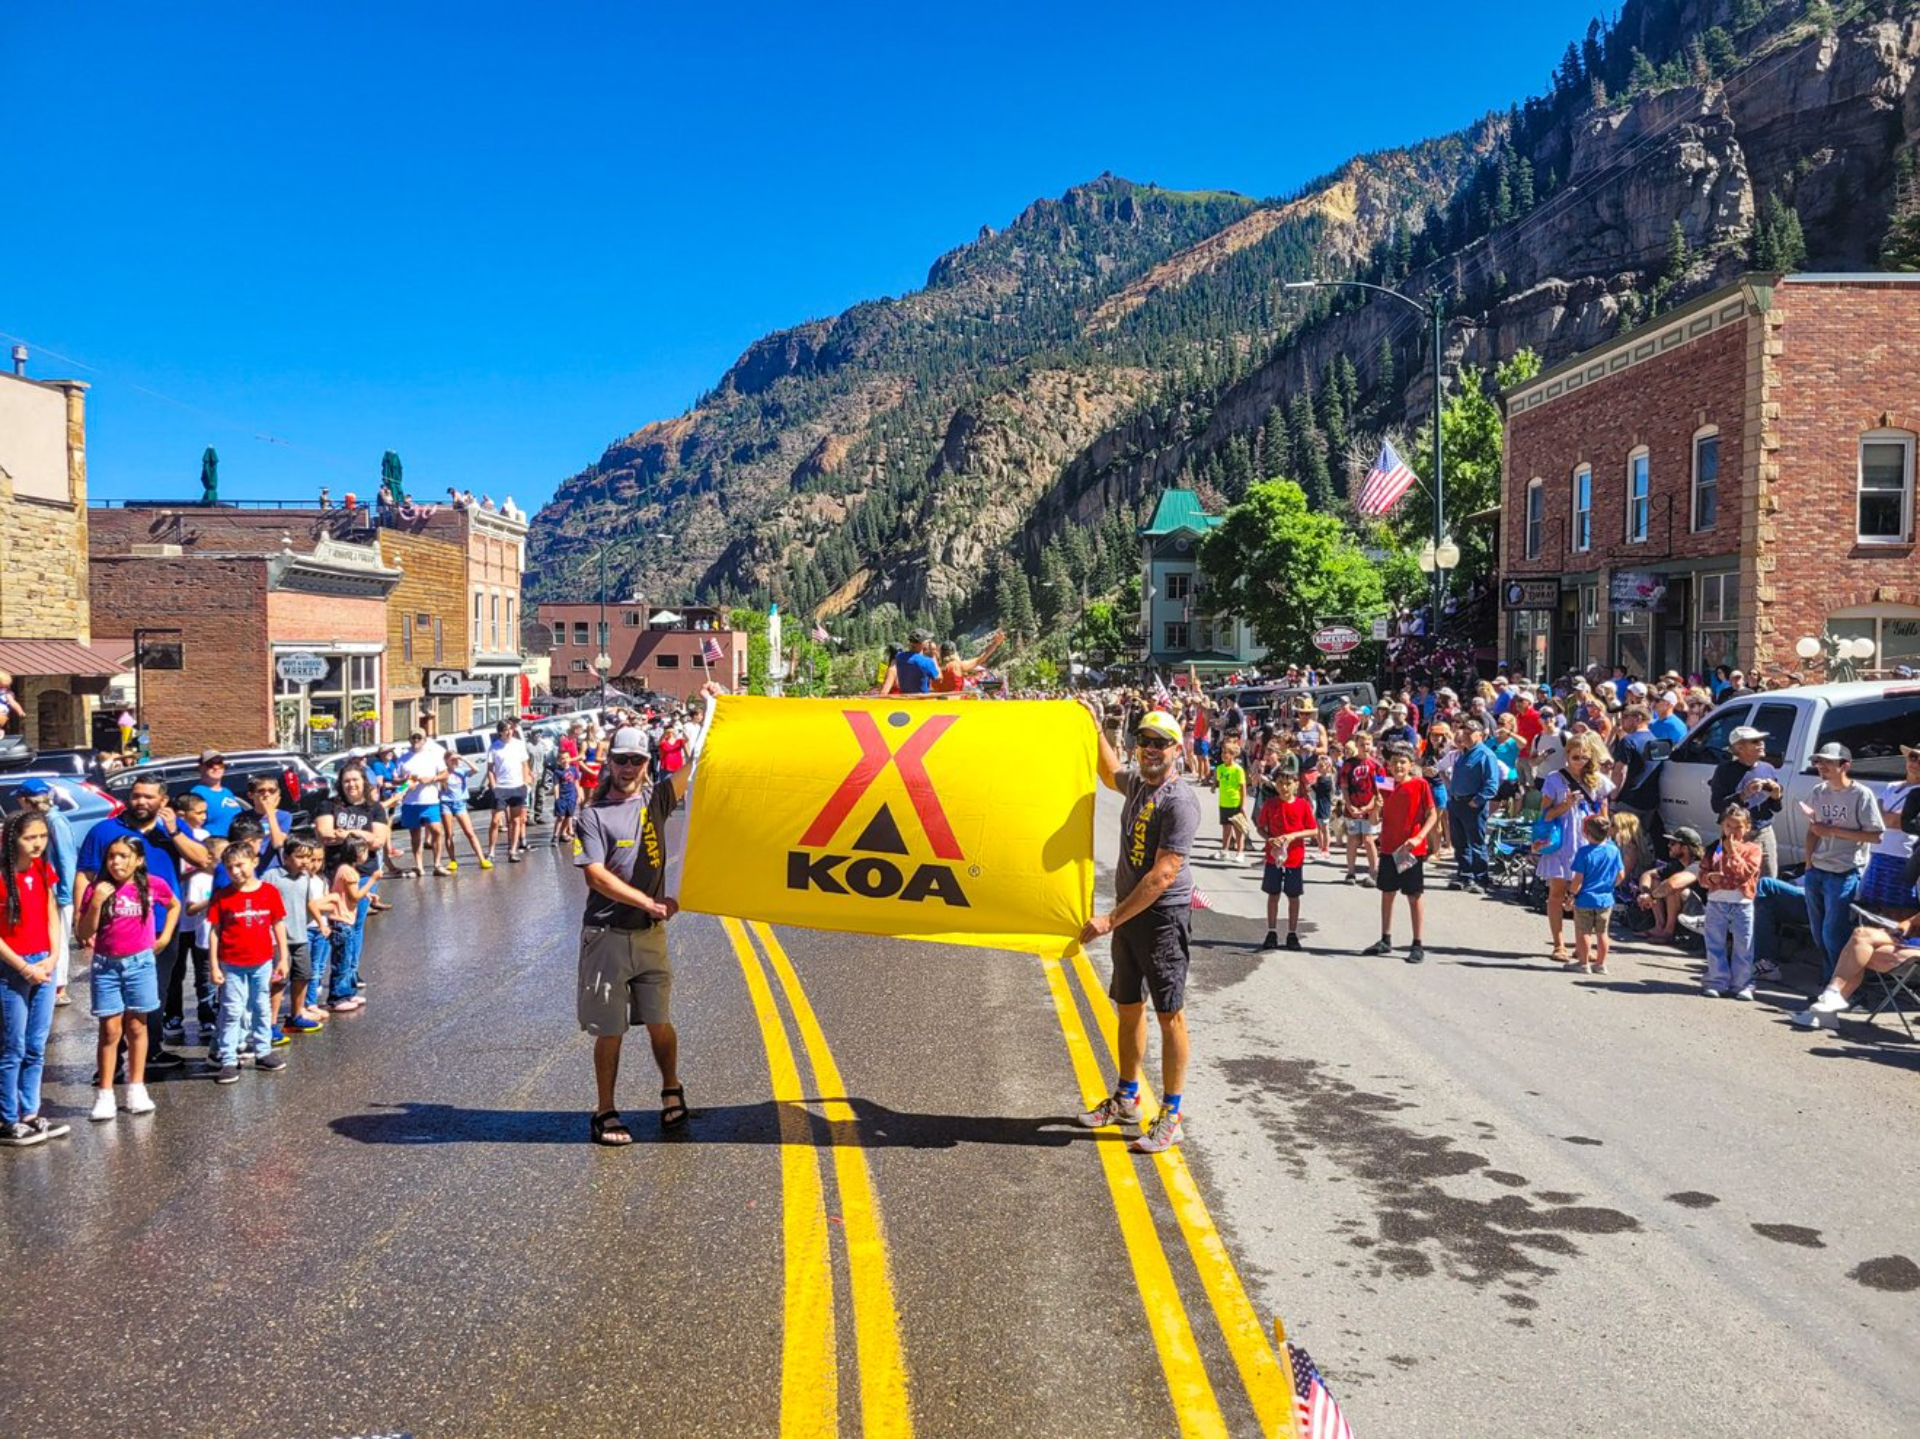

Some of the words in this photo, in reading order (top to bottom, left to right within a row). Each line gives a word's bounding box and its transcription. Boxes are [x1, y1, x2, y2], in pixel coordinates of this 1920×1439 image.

[283, 667, 320, 676] MARKET
[1821, 804, 1847, 819] USA
[644, 821, 661, 868] STAFF
[1129, 821, 1147, 867] STAFF
[786, 850, 972, 909] KOA
